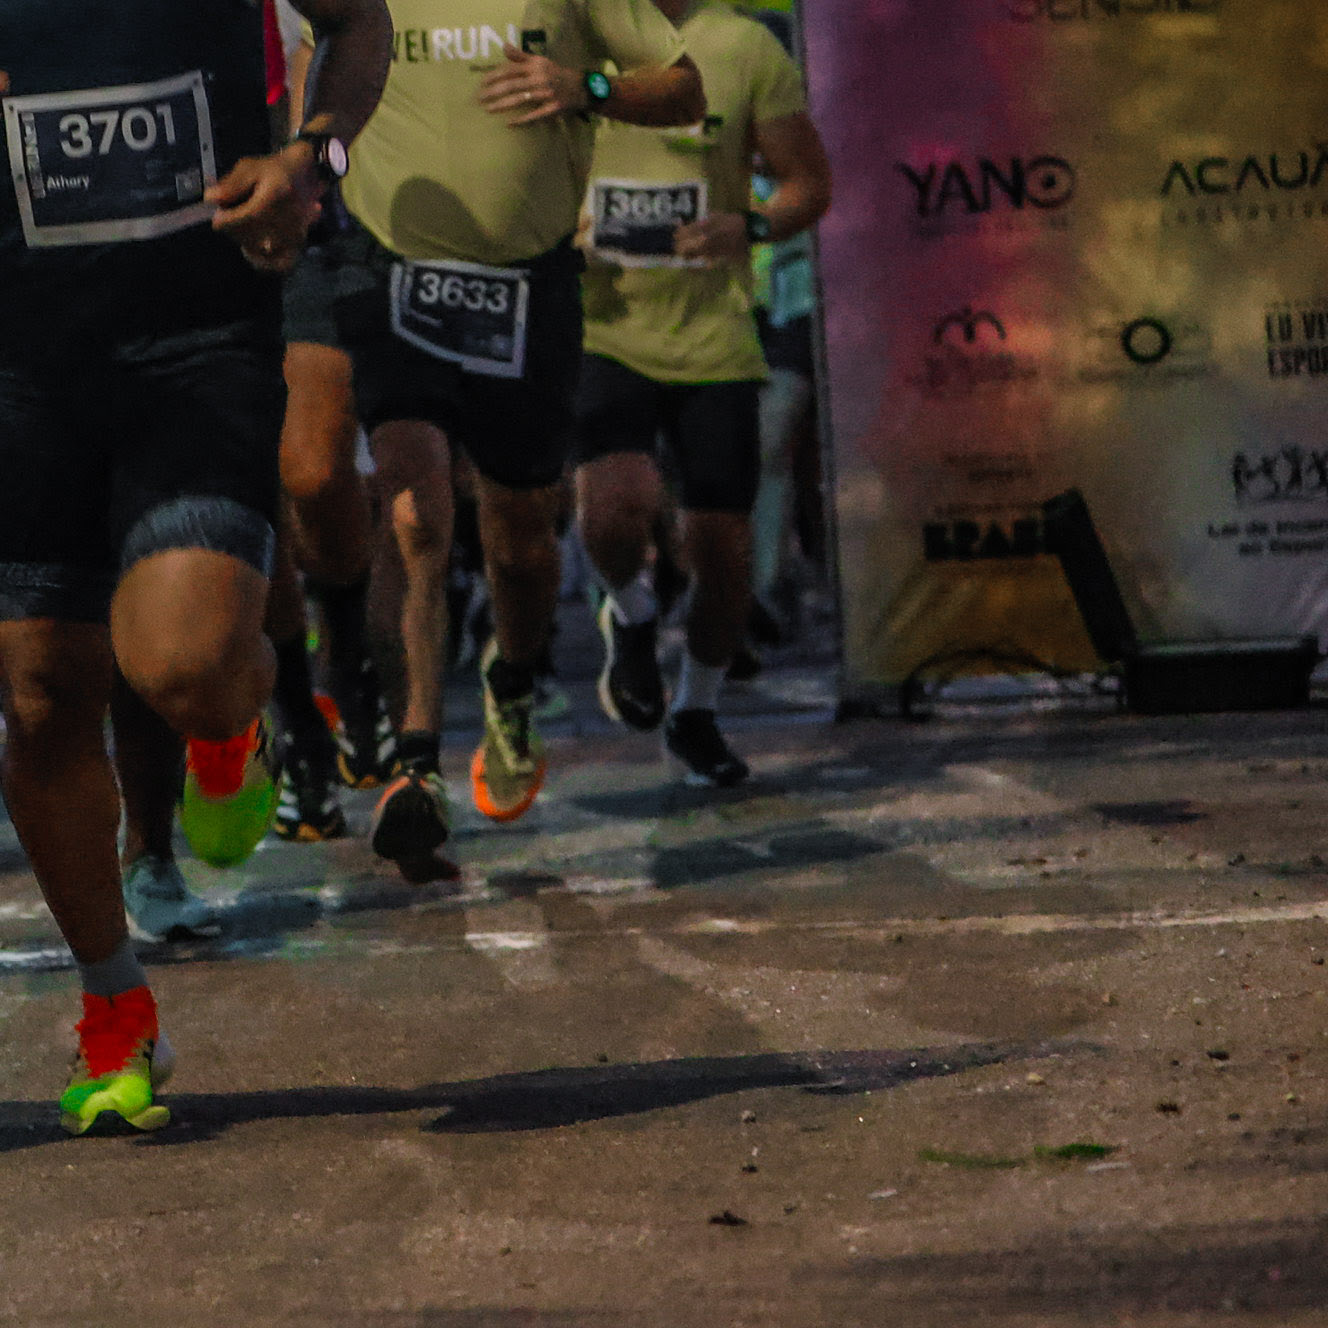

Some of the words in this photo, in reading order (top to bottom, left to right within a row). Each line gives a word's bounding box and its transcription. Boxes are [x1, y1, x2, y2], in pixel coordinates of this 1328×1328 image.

[392, 23, 519, 63] E!RUN
[58, 102, 177, 159] 3701
[417, 272, 509, 314] 3633
